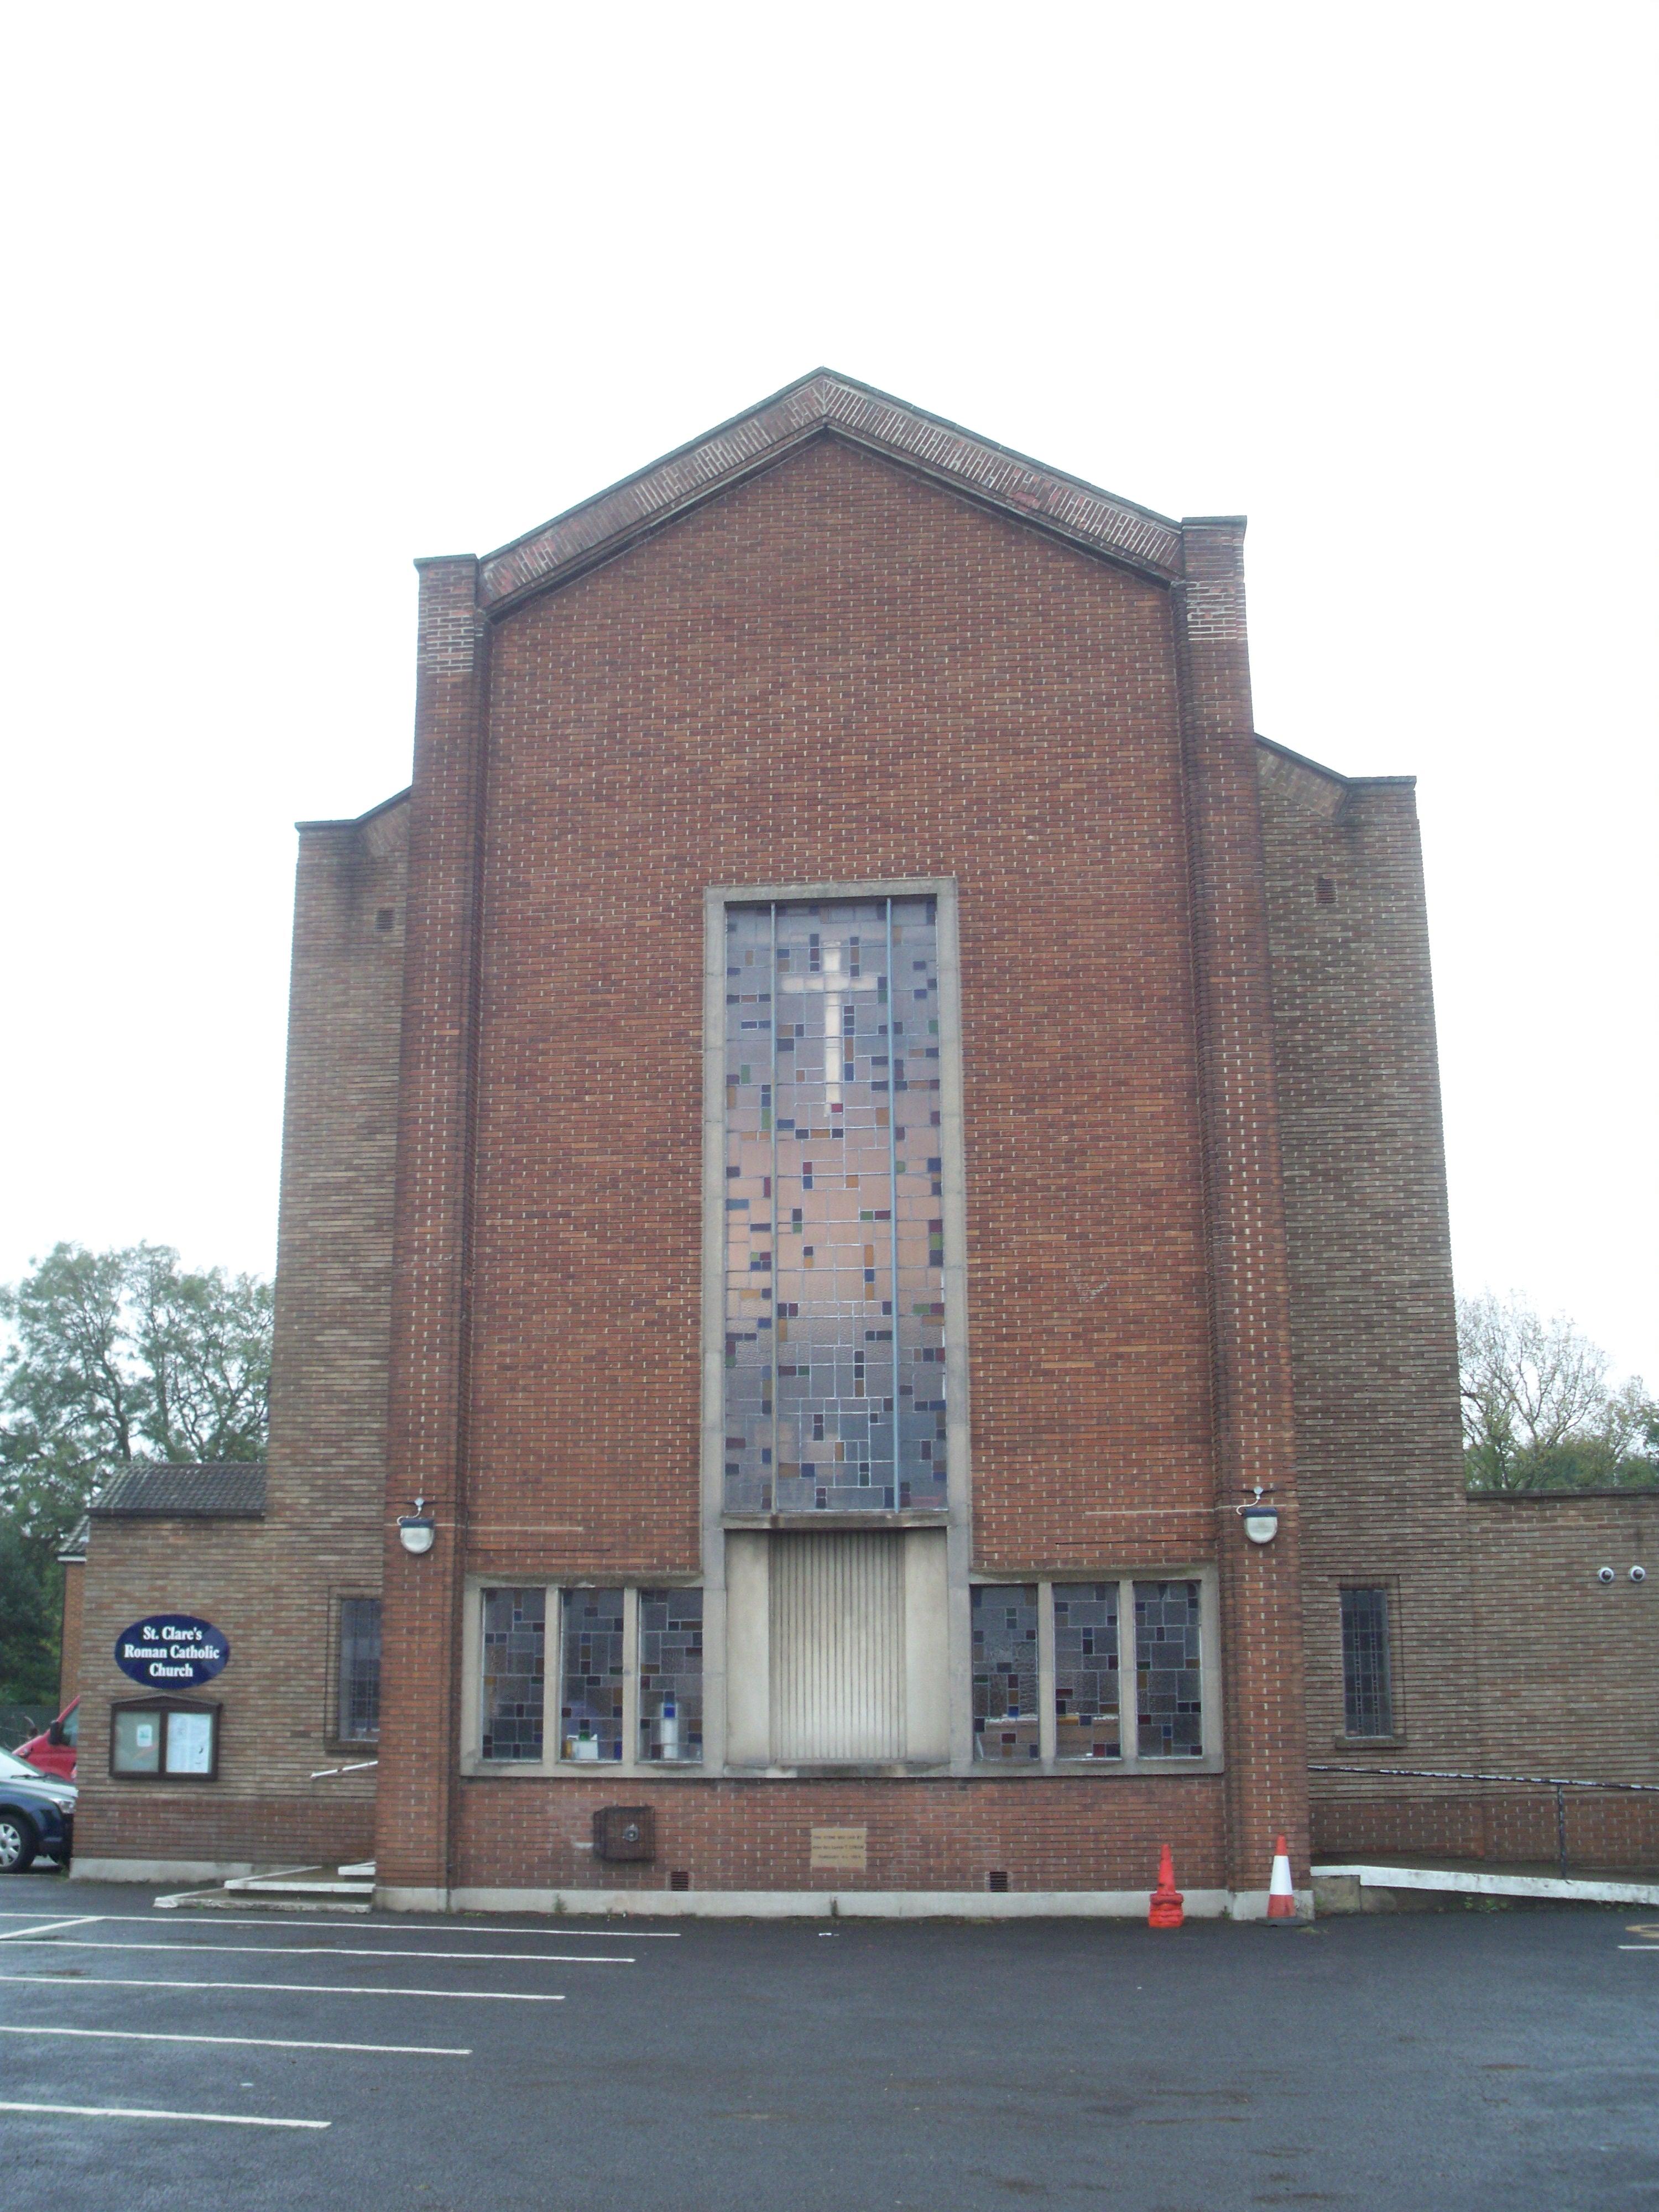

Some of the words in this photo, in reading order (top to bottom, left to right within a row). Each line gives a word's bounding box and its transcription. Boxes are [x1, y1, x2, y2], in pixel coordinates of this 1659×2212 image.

[143, 1626, 159, 1640] St.
[162, 1626, 202, 1641] Clare's
[124, 1644, 168, 1658] Roman
[170, 1645, 220, 1658] Catholic
[149, 1663, 193, 1677] Church
